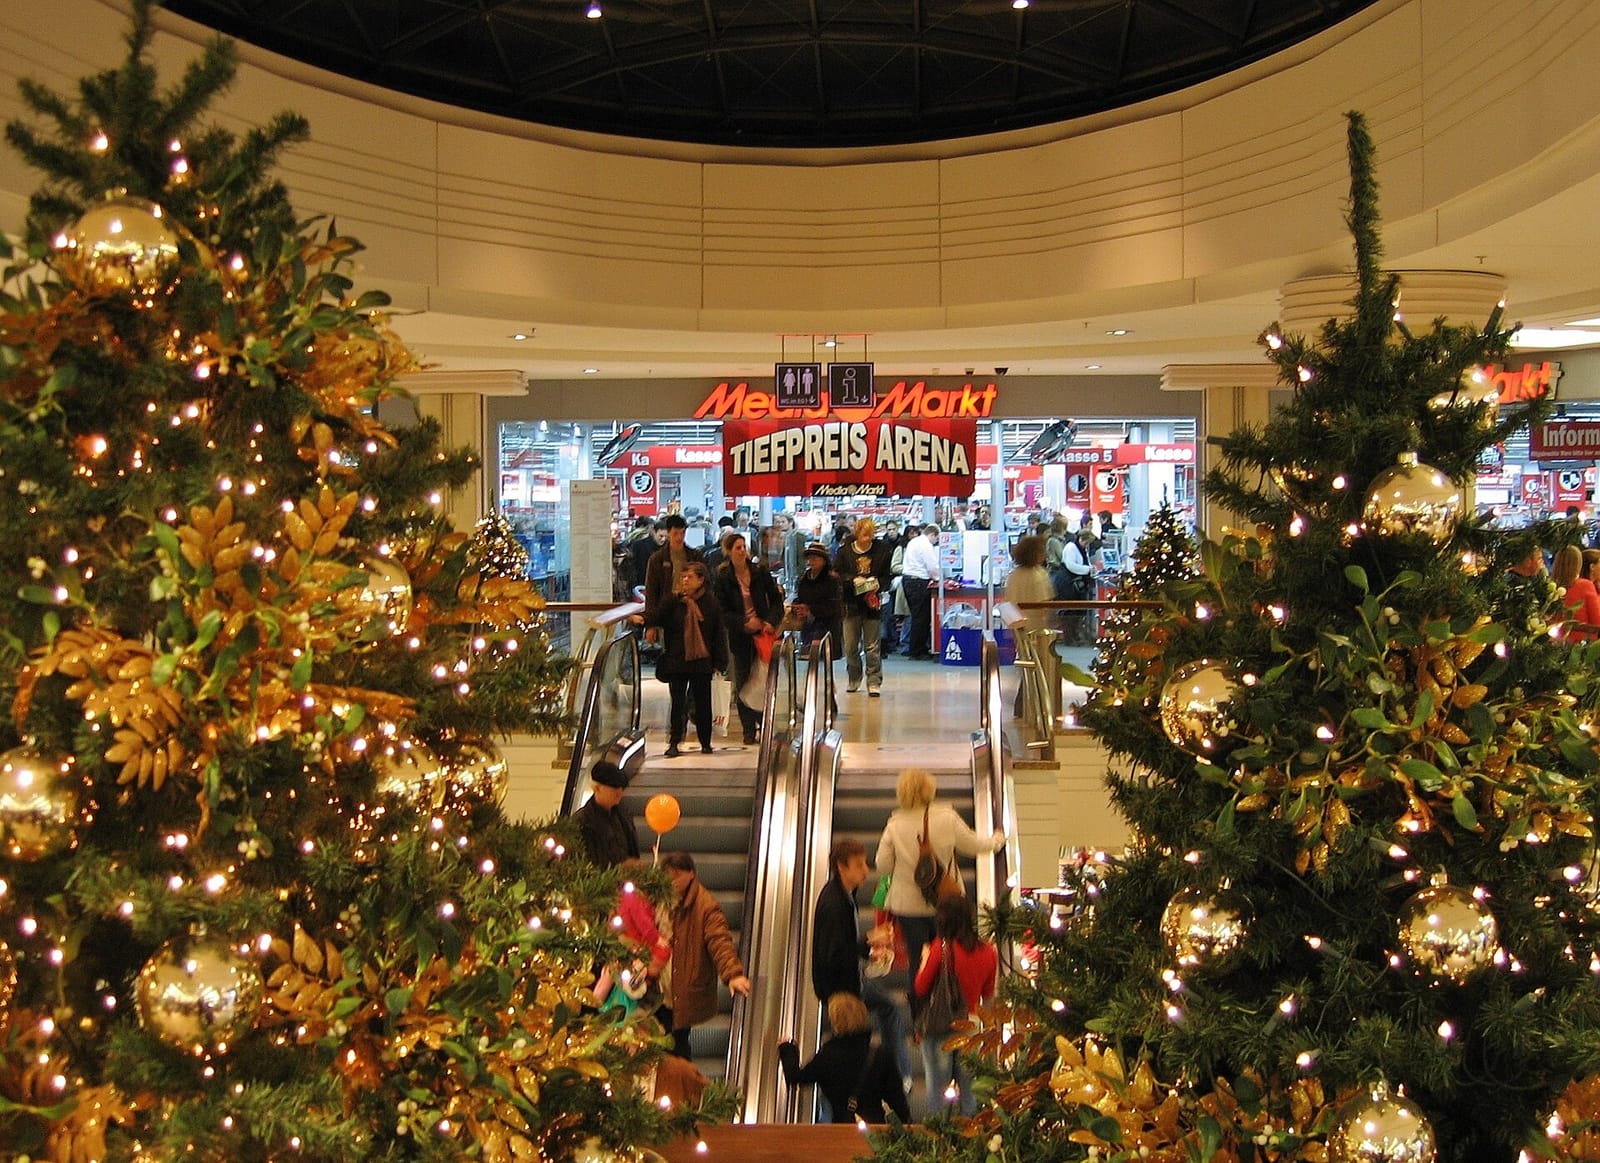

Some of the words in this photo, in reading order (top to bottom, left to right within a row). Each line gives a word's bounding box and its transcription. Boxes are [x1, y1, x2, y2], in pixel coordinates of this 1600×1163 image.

[694, 382, 829, 418] Mea
[871, 382, 998, 417] Markt
[729, 422, 867, 475] TIEFPREIS
[876, 424, 970, 475] ARENA
[1144, 446, 1193, 460] Kasse
[1103, 450, 1113, 462] 5
[814, 484, 848, 496] Media
[855, 484, 886, 495] Markt
[945, 652, 962, 661] AOL
